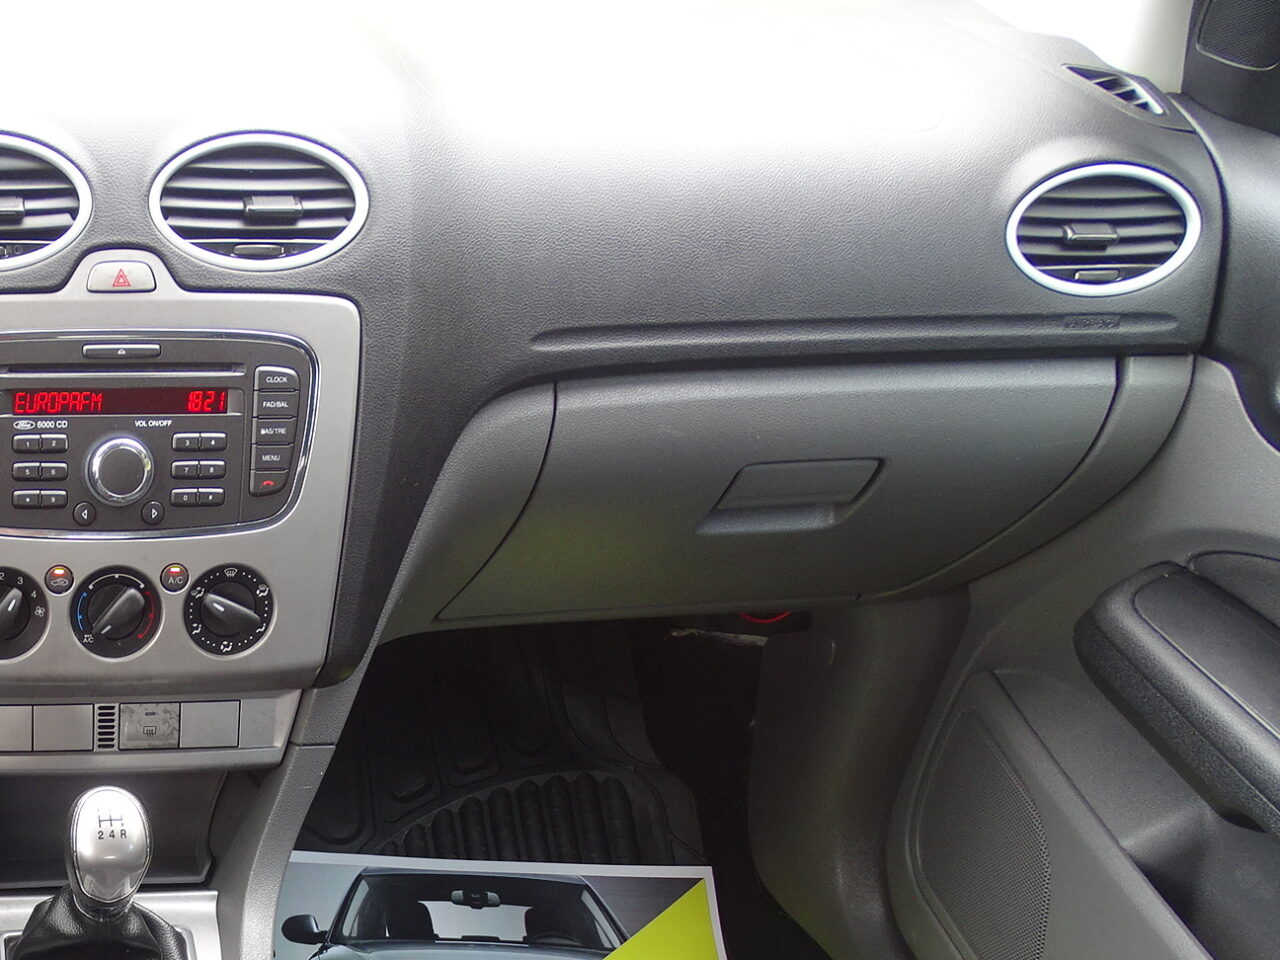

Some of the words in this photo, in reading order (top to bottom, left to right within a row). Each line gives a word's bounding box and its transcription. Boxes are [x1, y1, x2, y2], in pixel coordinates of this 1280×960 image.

[37, 421, 55, 429] 6000
[56, 420, 68, 428] CD
[148, 419, 172, 427] ON/OFF
[168, 576, 184, 584] A/C
[0, 572, 5, 580] 2
[17, 576, 23, 584] 3
[31, 590, 37, 598] 4
[98, 830, 104, 840] 2
[109, 830, 115, 839] 4
[120, 829, 127, 839] R
